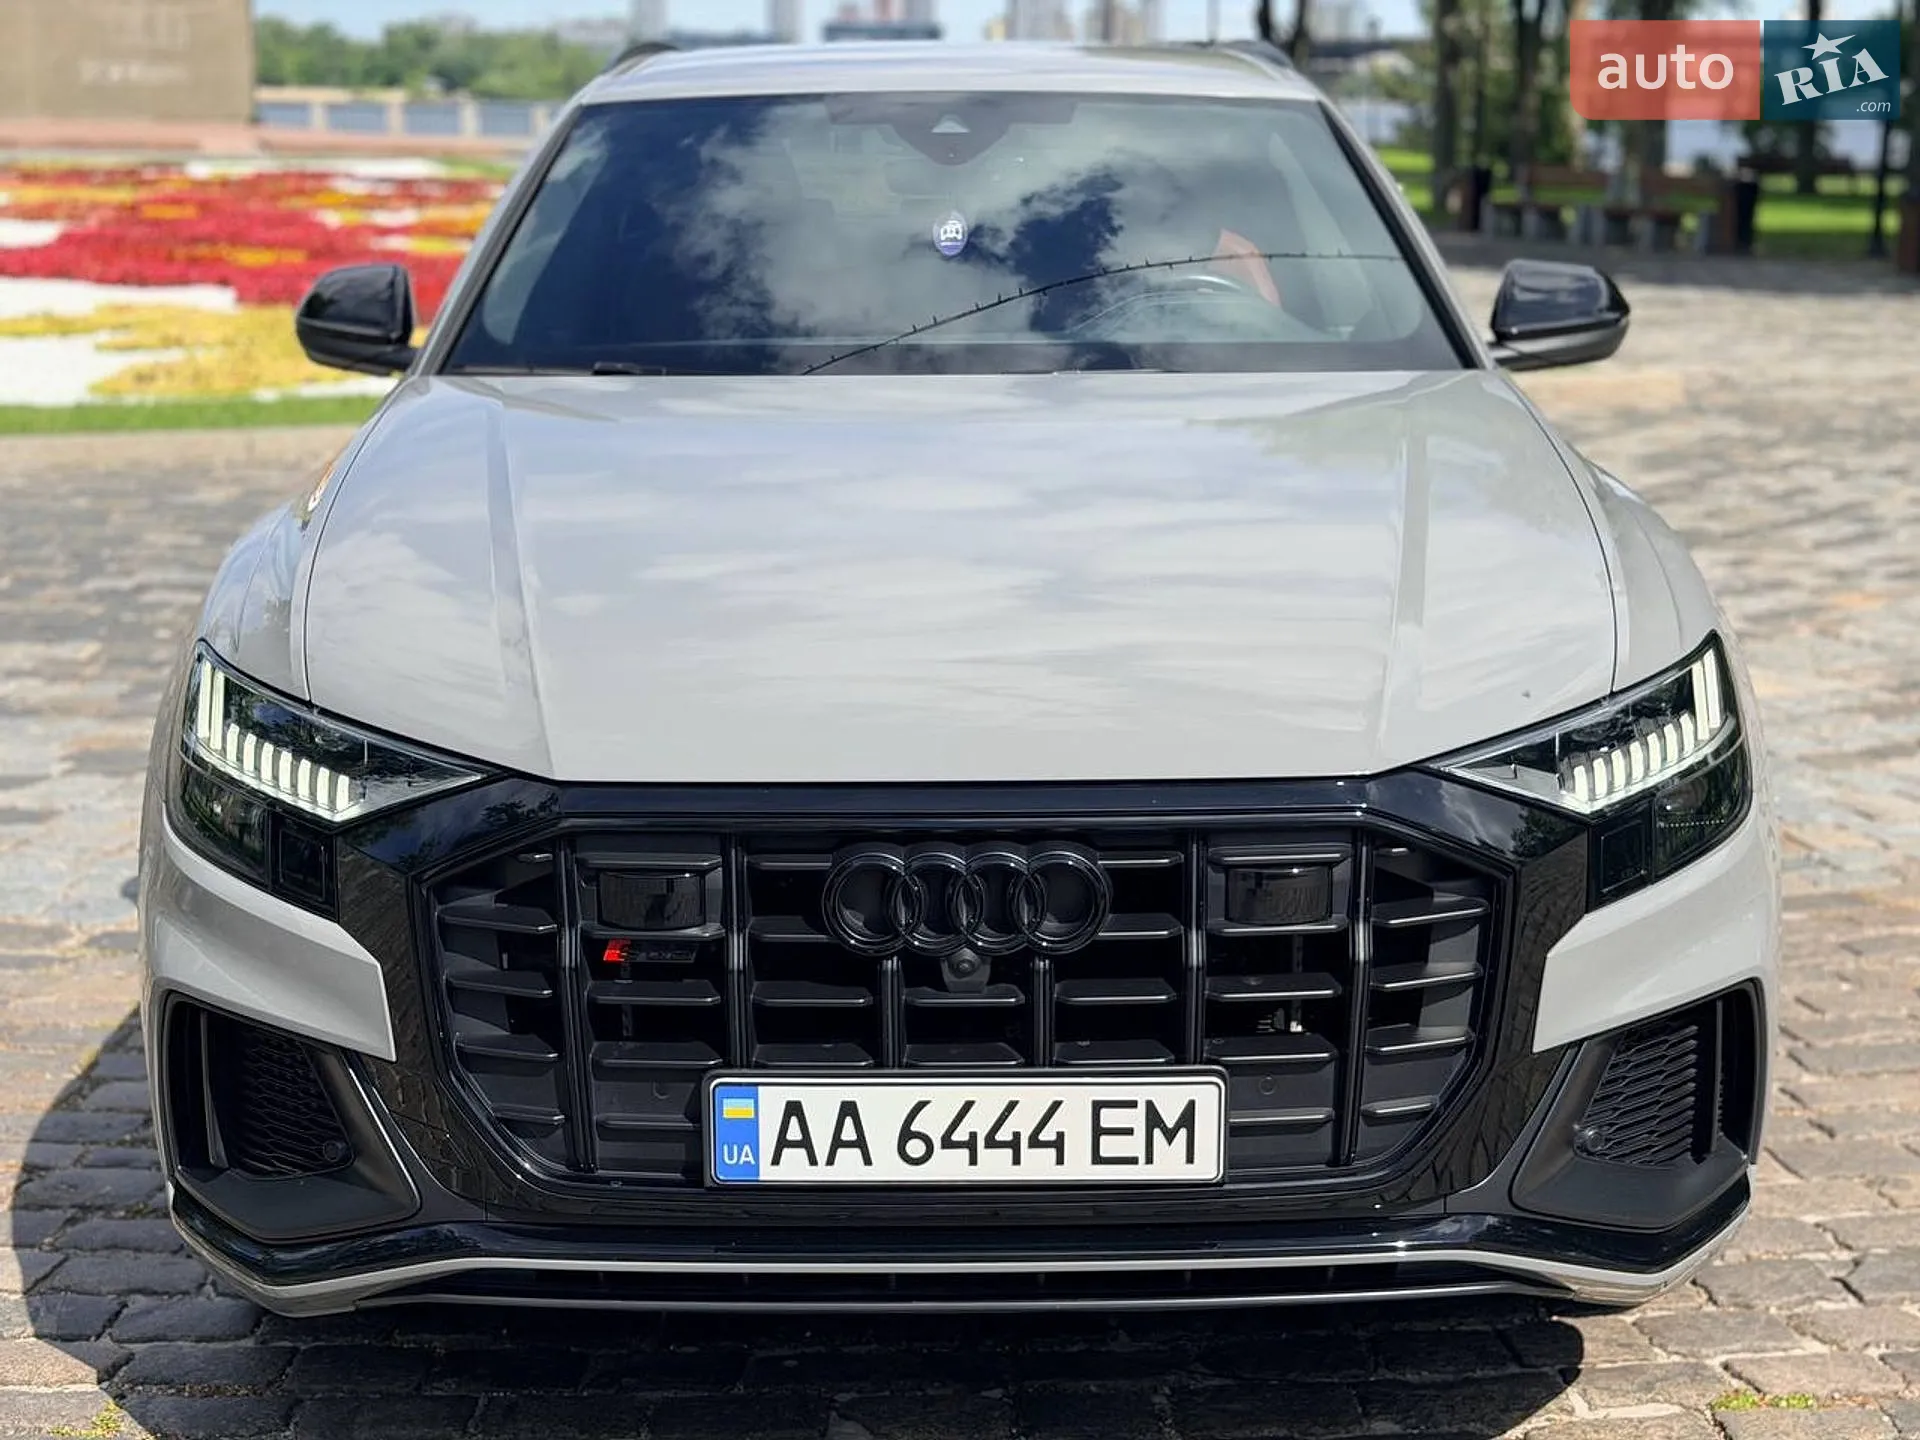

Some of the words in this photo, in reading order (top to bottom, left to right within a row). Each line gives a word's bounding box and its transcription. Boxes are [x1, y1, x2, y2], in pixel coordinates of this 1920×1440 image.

[722, 1144, 756, 1165] UA
[770, 1099, 873, 1167] AA
[896, 1099, 1066, 1167] 6444
[1090, 1099, 1196, 1166] EM
